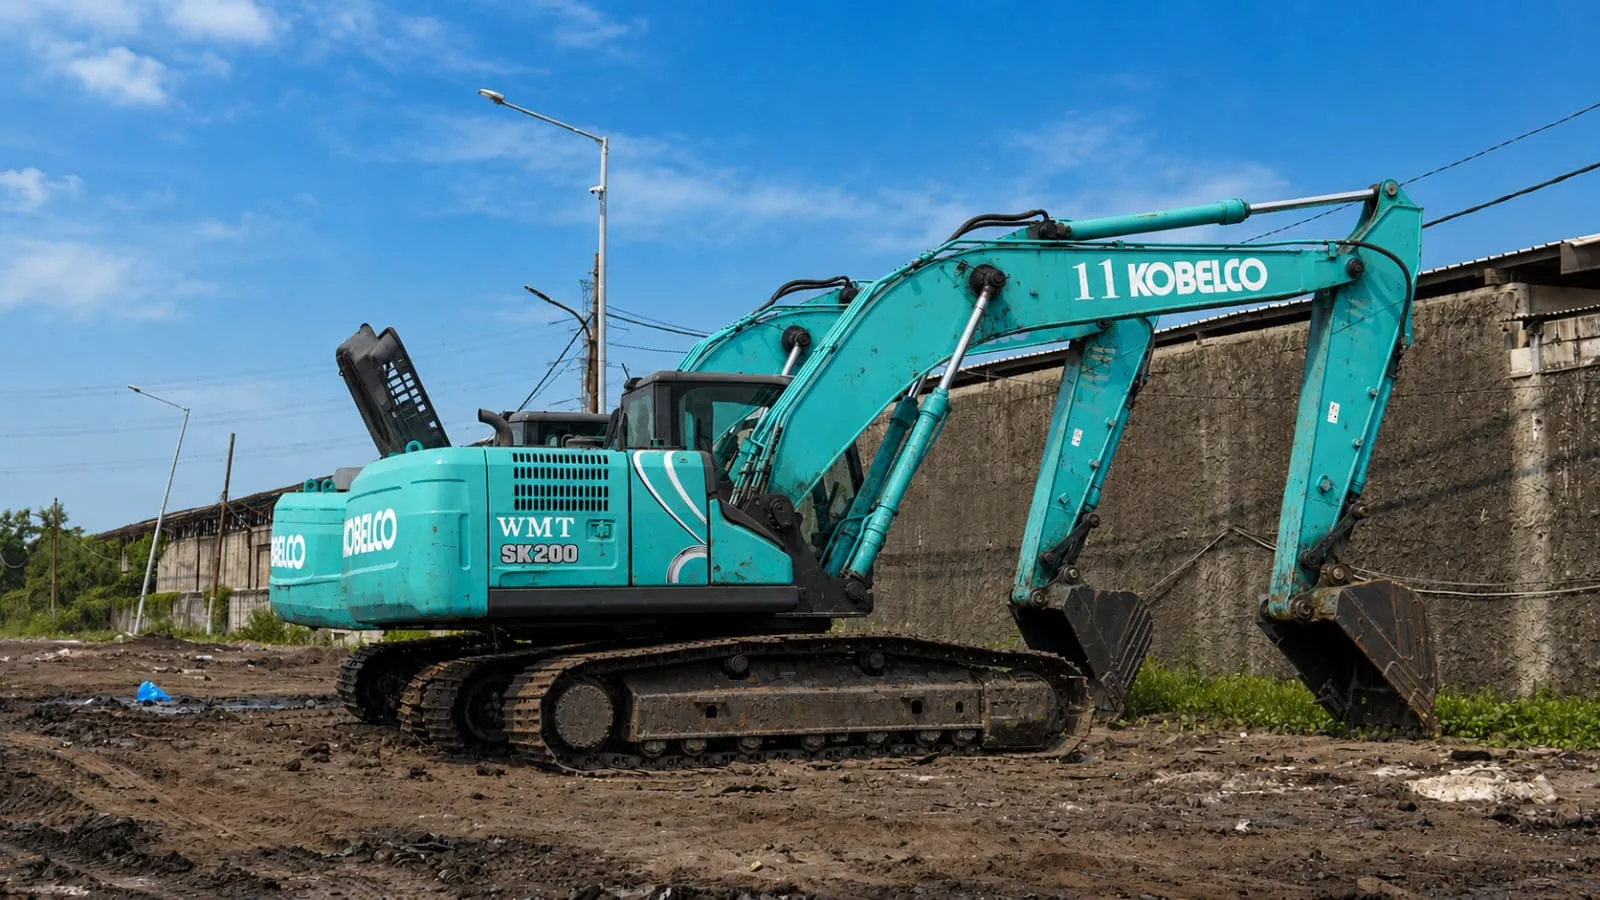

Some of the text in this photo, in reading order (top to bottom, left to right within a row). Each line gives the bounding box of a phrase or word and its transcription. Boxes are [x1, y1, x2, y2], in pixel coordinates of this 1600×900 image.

[1072, 257, 1268, 300] 11 KOBELCO
[496, 516, 575, 538] WMT
[271, 534, 306, 569] BELCO
[501, 543, 579, 564] SK200
